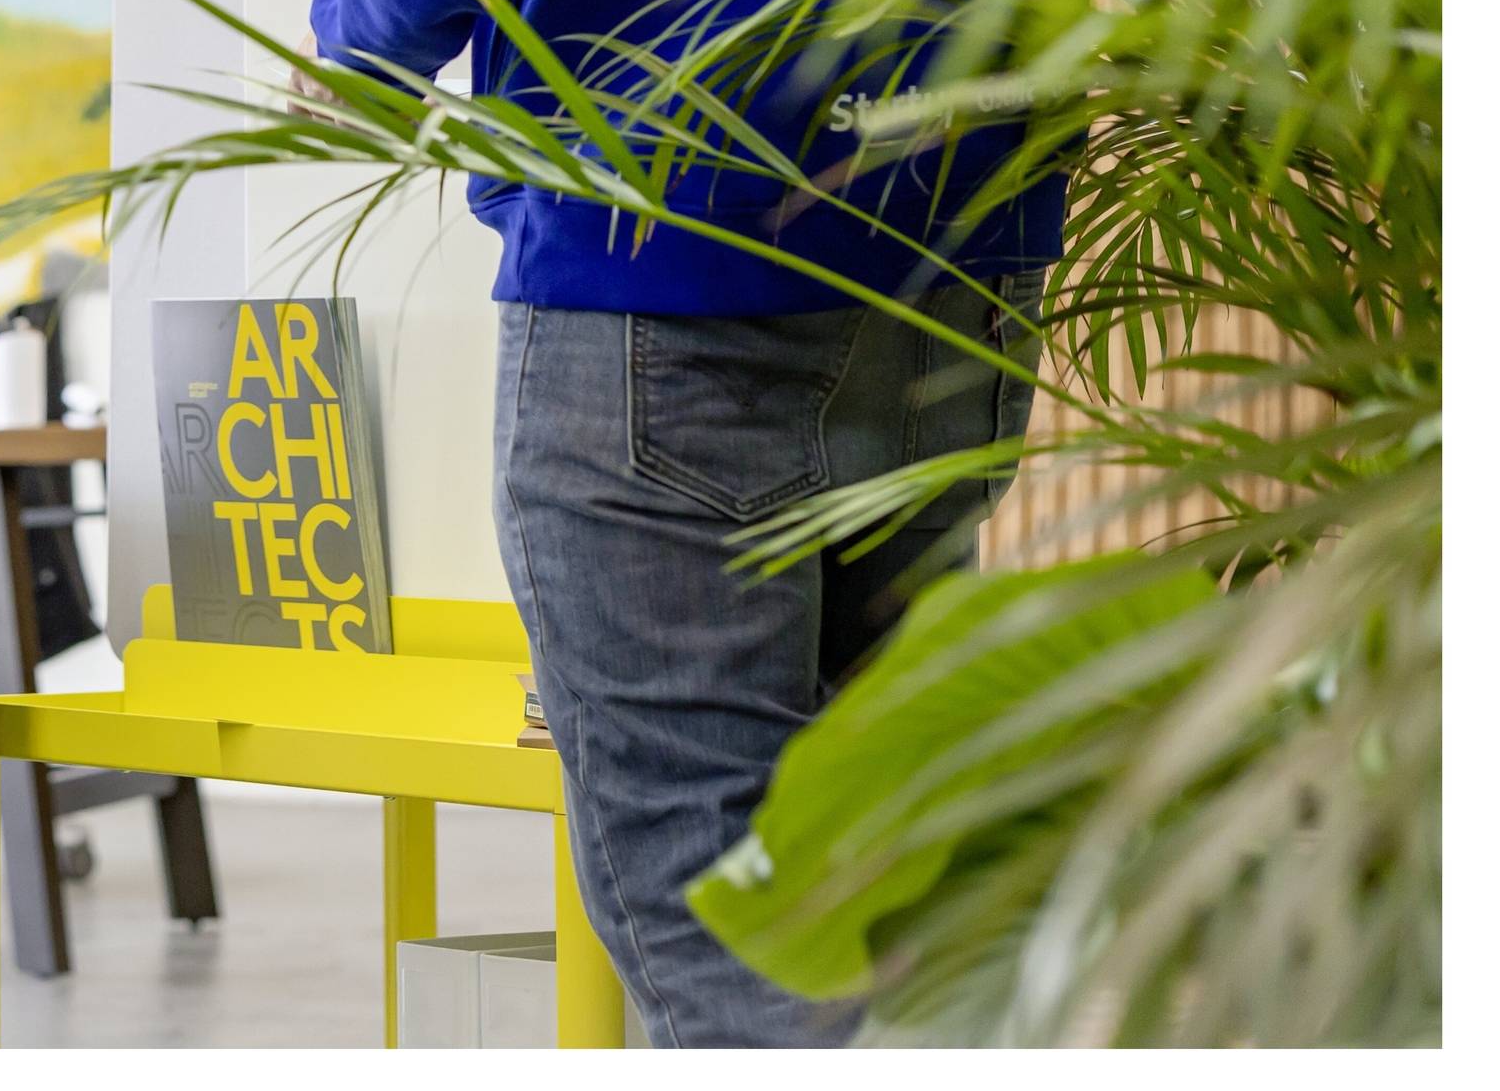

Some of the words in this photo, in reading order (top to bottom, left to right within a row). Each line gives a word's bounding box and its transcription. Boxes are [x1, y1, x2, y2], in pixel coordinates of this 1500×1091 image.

[227, 303, 339, 399] AR
[217, 402, 352, 499] CHI
[213, 501, 365, 601] TEC
